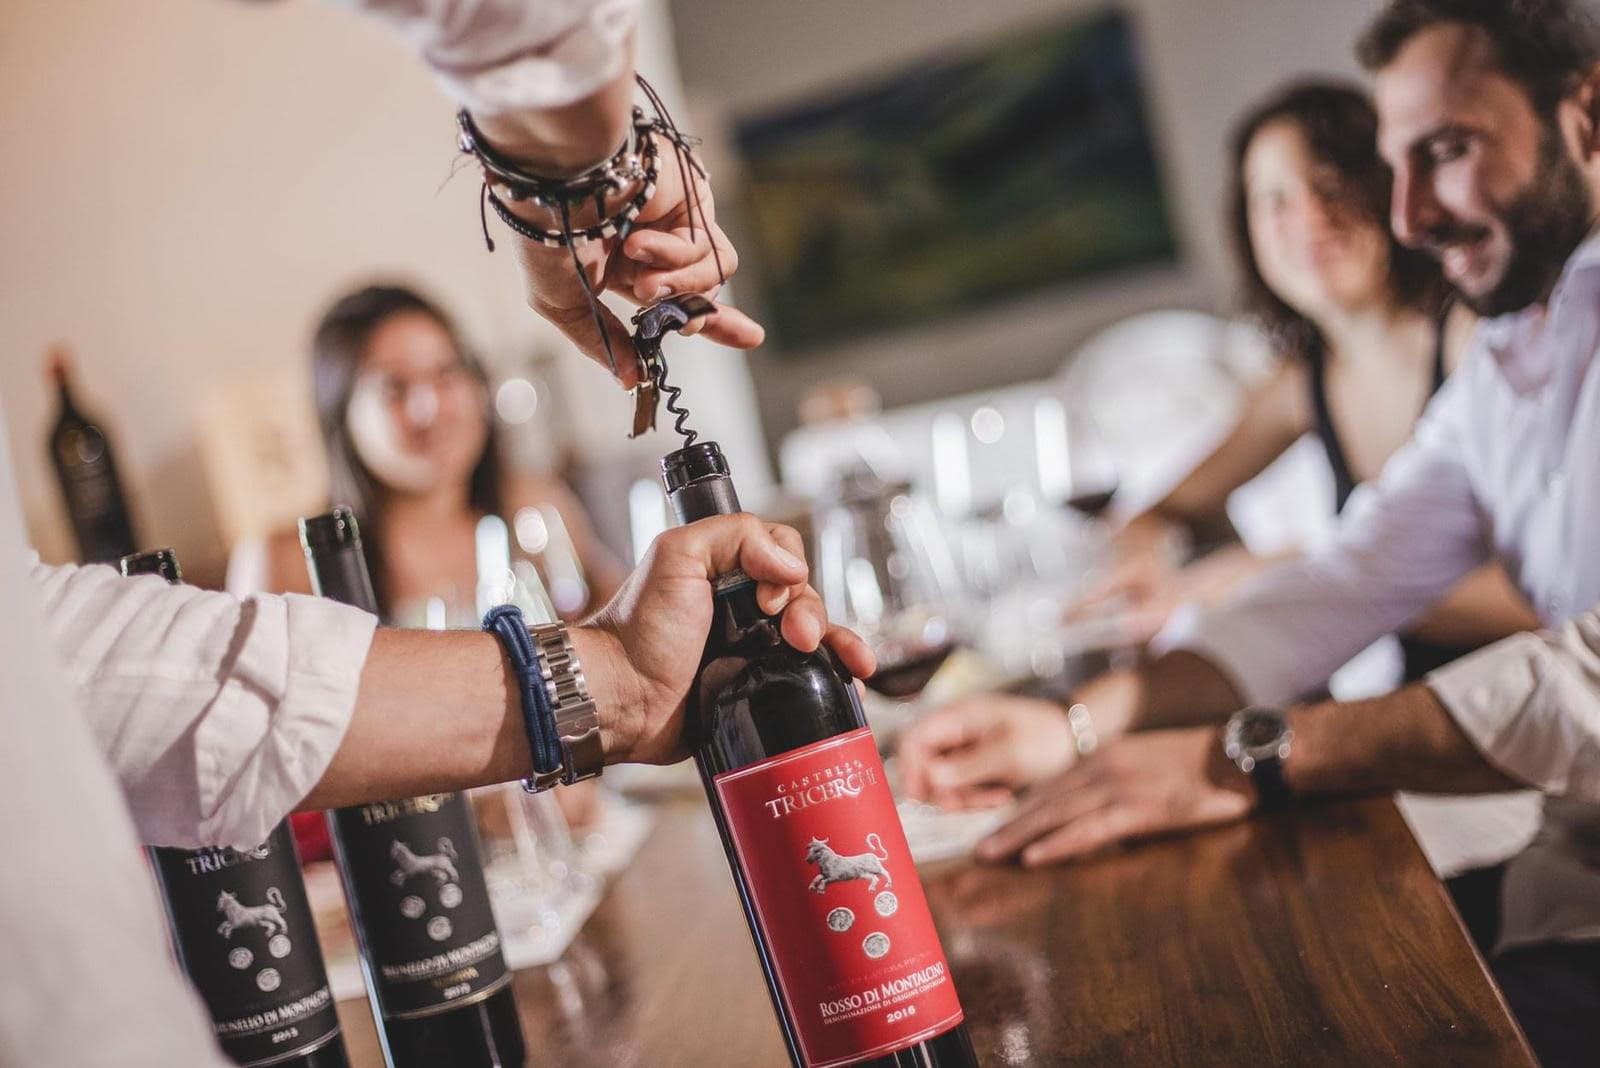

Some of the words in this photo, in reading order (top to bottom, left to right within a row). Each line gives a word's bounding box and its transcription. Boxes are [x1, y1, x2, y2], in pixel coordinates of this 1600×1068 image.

[765, 767, 878, 819] TRICERCHI
[777, 759, 863, 793] CASTELLO
[819, 995, 861, 1017] ROSSO
[863, 988, 880, 1005] DI
[881, 961, 944, 999] MONTALCINO
